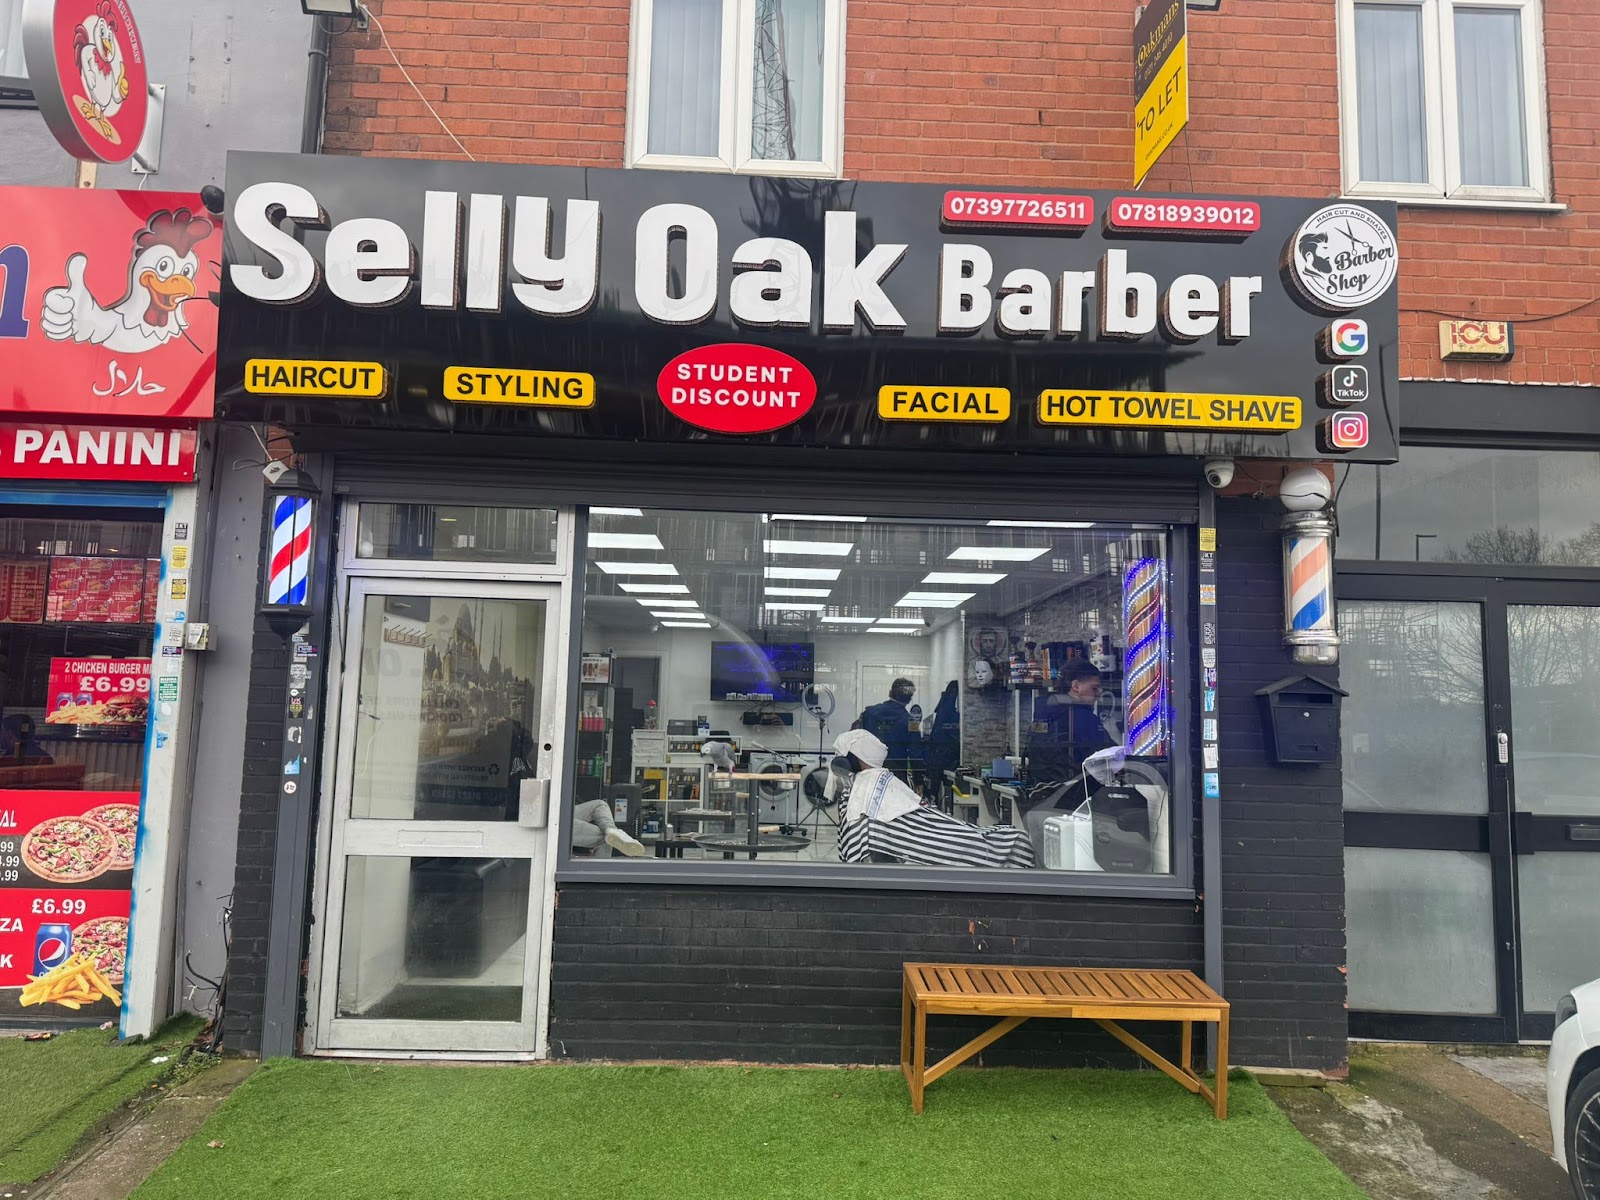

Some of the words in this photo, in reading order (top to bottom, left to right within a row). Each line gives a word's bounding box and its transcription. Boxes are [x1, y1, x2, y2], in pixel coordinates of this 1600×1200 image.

[1138, 2, 1179, 67] Oakmans
[1137, 106, 1154, 141] TO
[1158, 66, 1182, 116] LET
[950, 197, 1086, 220] 07397726511
[1118, 203, 1254, 225] 07818939012
[1316, 212, 1333, 223] HAIR
[1351, 210, 1366, 220] AND
[1366, 216, 1388, 240] SHAVES
[229, 181, 600, 314] Selly
[635, 203, 909, 326] Oak
[940, 243, 1262, 338] Barber
[1334, 245, 1393, 271] Barber
[1326, 273, 1371, 295] Shop
[1451, 322, 1506, 345] ICU
[92, 359, 166, 397] حلال
[252, 366, 376, 390] HAIRCUT
[677, 363, 793, 384] STUDENT
[456, 373, 583, 400] STYLING
[671, 387, 801, 408] DISCOUNT
[1337, 389, 1364, 397] TikTok
[892, 391, 999, 415] FACIAL
[1046, 395, 1101, 417] HOT
[1109, 398, 1200, 420] TOWEL
[1209, 400, 1296, 424] SHAVE
[13, 429, 182, 466] PANINI
[64, 662, 70, 673] 2
[72, 662, 107, 674] CHICKEN
[109, 663, 140, 674] BURGER
[80, 676, 150, 692] £6.99
[31, 898, 86, 915] £6.99
